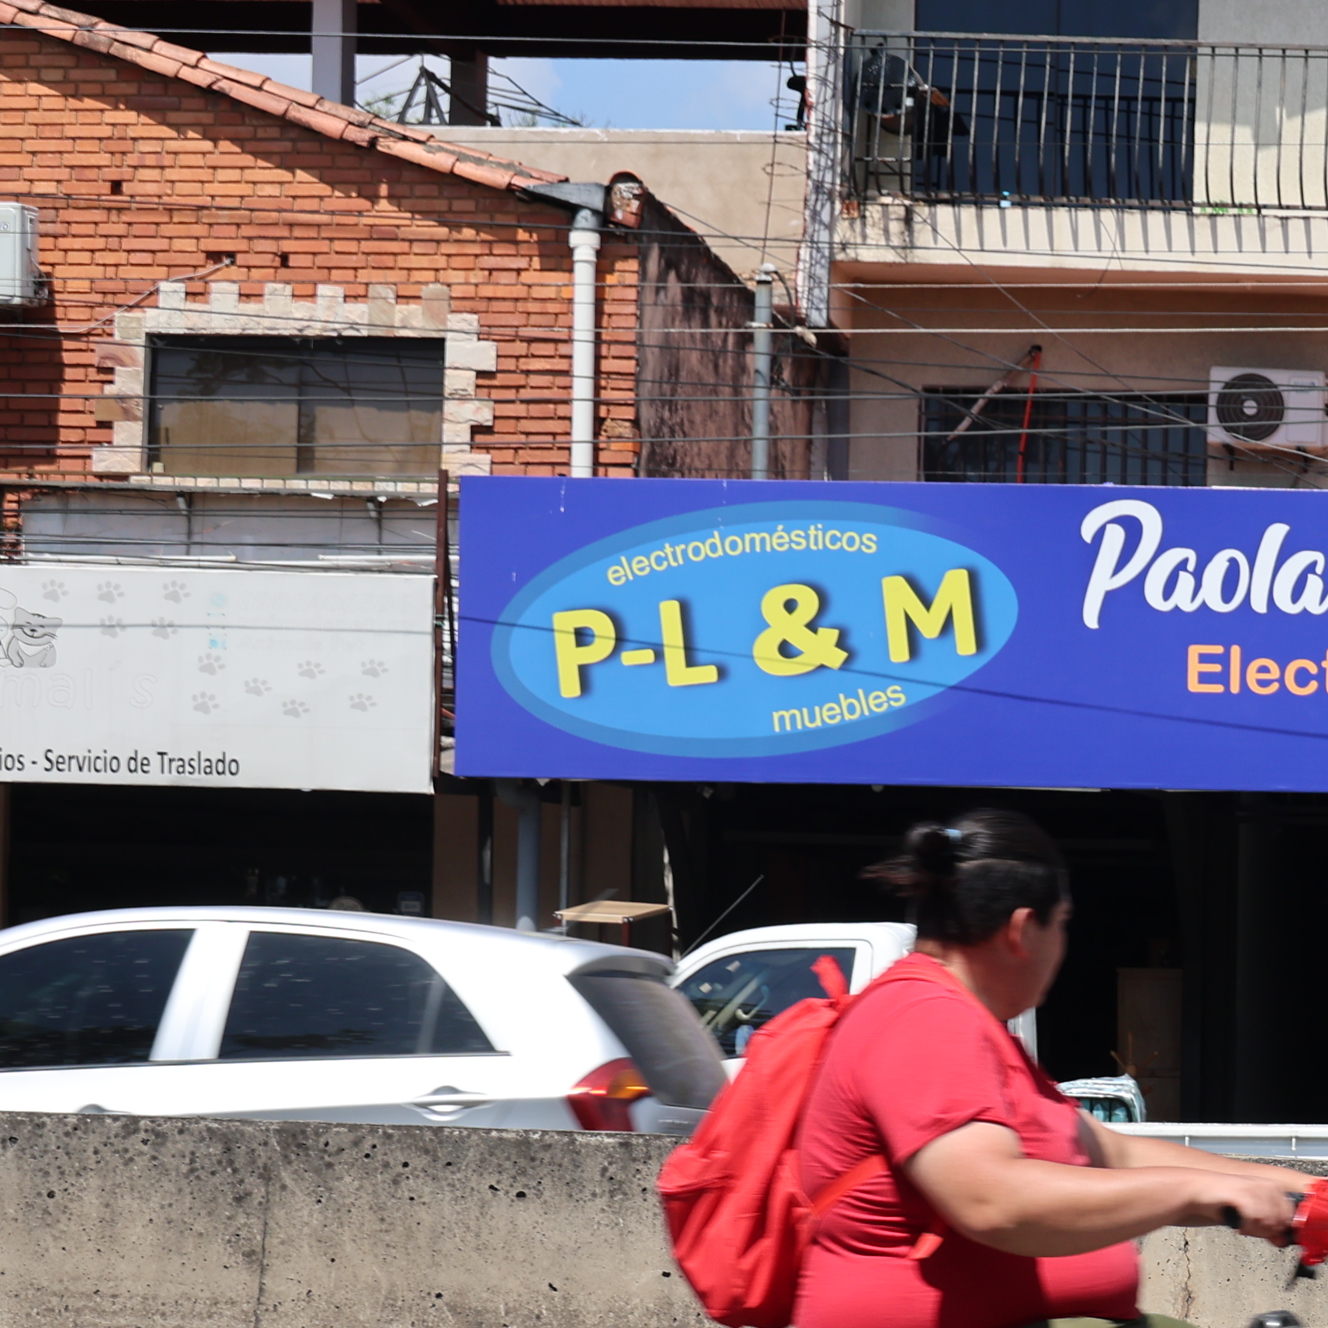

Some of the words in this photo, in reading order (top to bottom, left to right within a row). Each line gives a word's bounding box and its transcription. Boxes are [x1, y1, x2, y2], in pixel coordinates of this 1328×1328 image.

[607, 523, 878, 586] electrodomésticos
[552, 599, 719, 697] P-L
[752, 583, 849, 676] &
[881, 568, 977, 662] M
[771, 684, 906, 732] muebles
[44, 749, 121, 775] Servicio
[127, 749, 151, 775] de
[157, 750, 240, 776] Traslado
